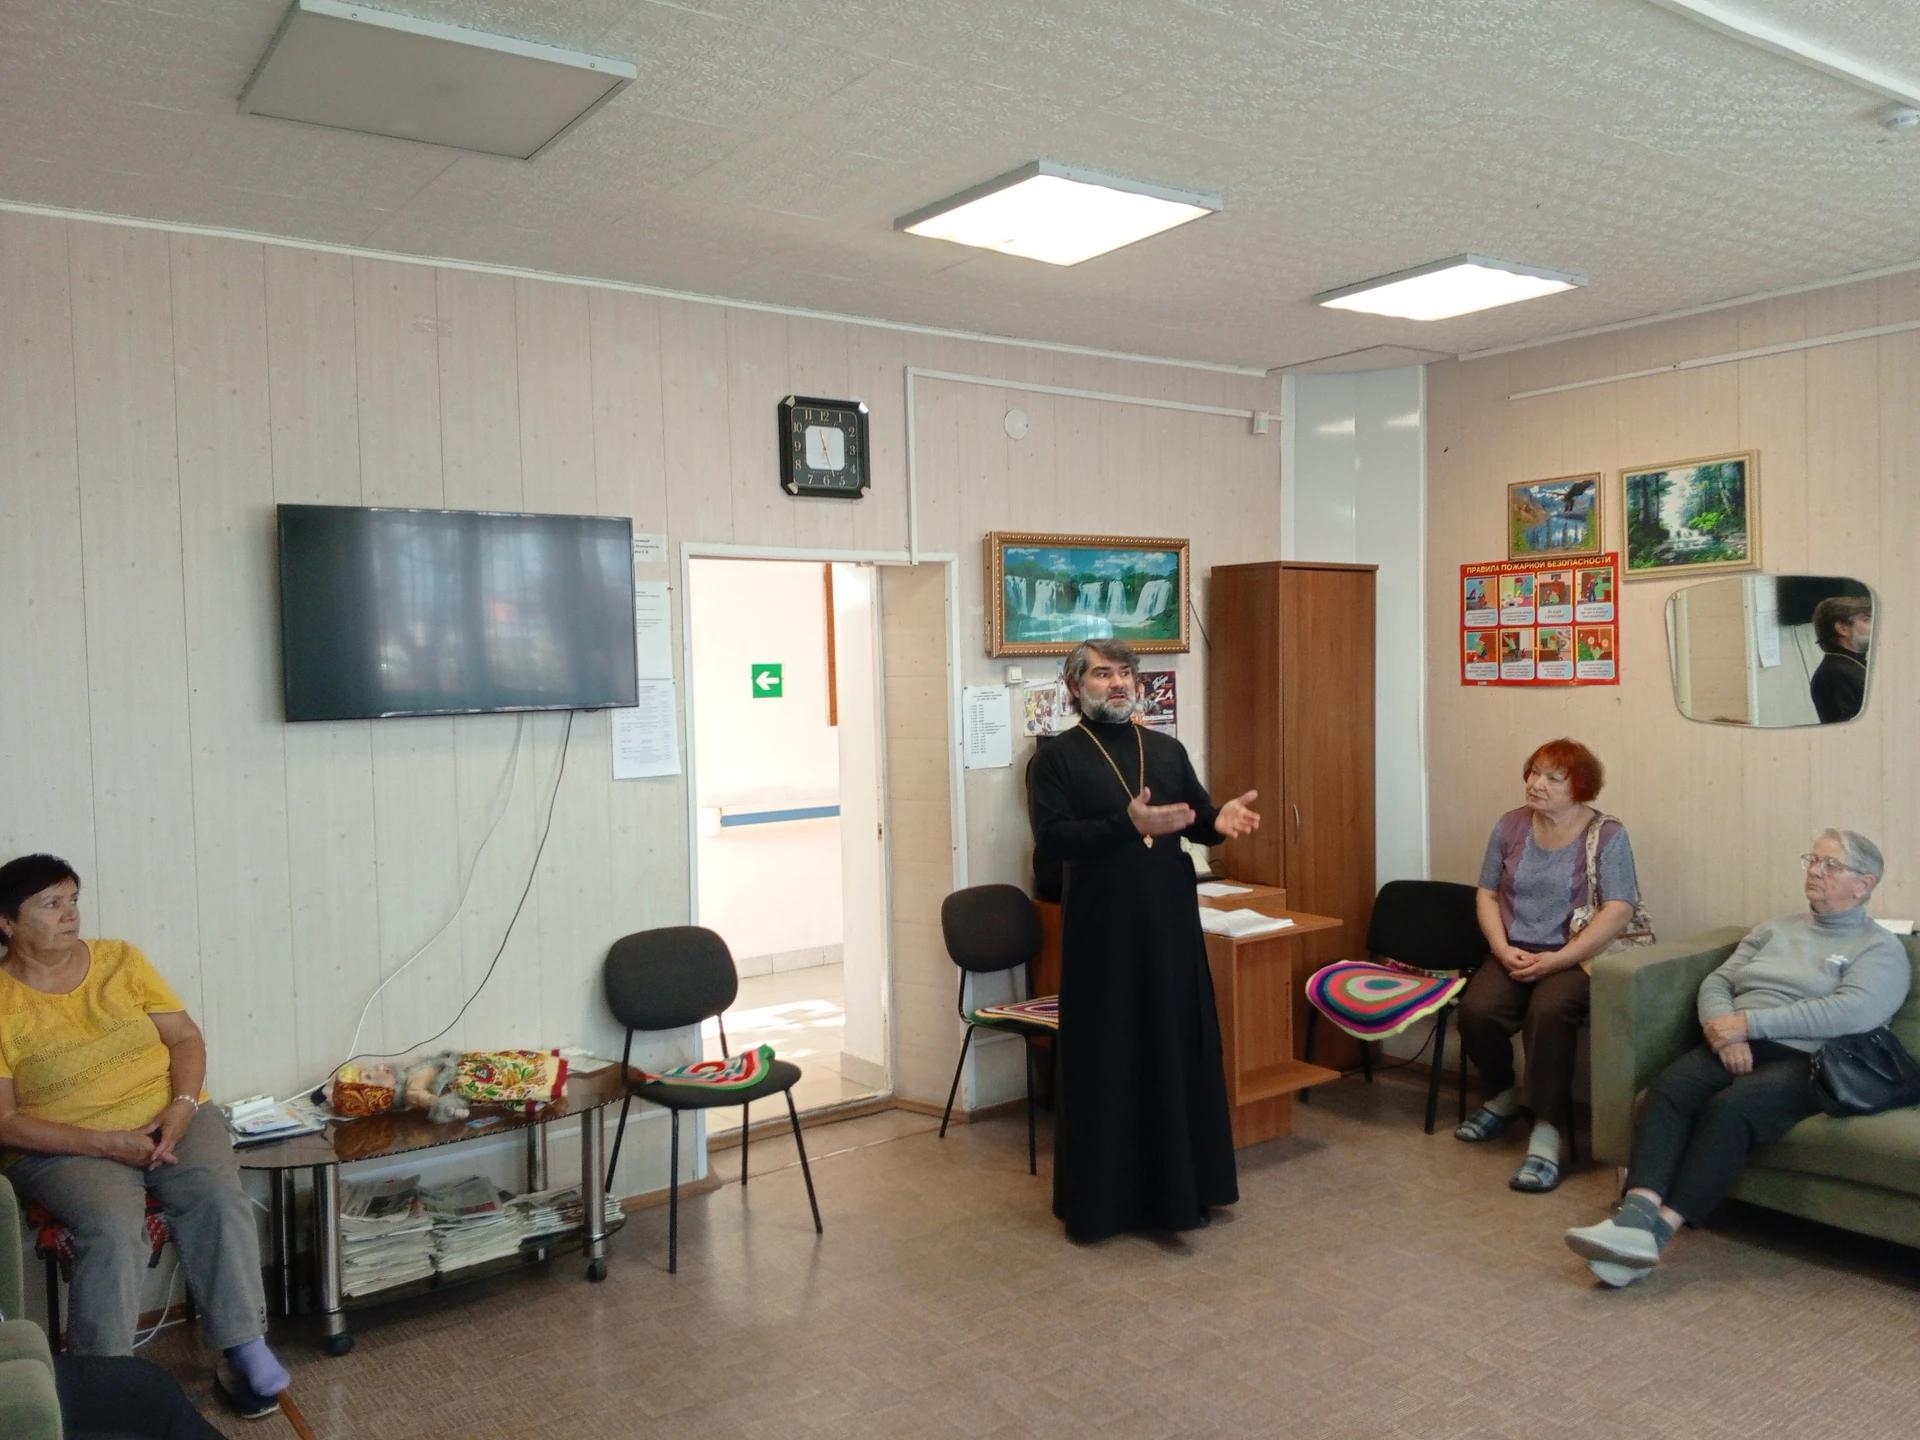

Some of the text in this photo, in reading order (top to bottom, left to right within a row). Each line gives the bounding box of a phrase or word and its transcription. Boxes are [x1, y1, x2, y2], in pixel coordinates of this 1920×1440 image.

[805, 409, 812, 420] 11
[820, 411, 830, 422] 12
[793, 422, 802, 433] 10
[848, 427, 856, 438] 2
[794, 441, 801, 452] 9
[849, 445, 856, 456] 3
[795, 459, 802, 470] 8
[849, 464, 856, 474] 4
[807, 474, 814, 485] 7
[823, 475, 830, 486] 6
[839, 475, 846, 486] 5
[1466, 556, 1612, 574] ПРАВИЛА ПОЖАРНОЙ БЕЗОПАСНОСТИ
